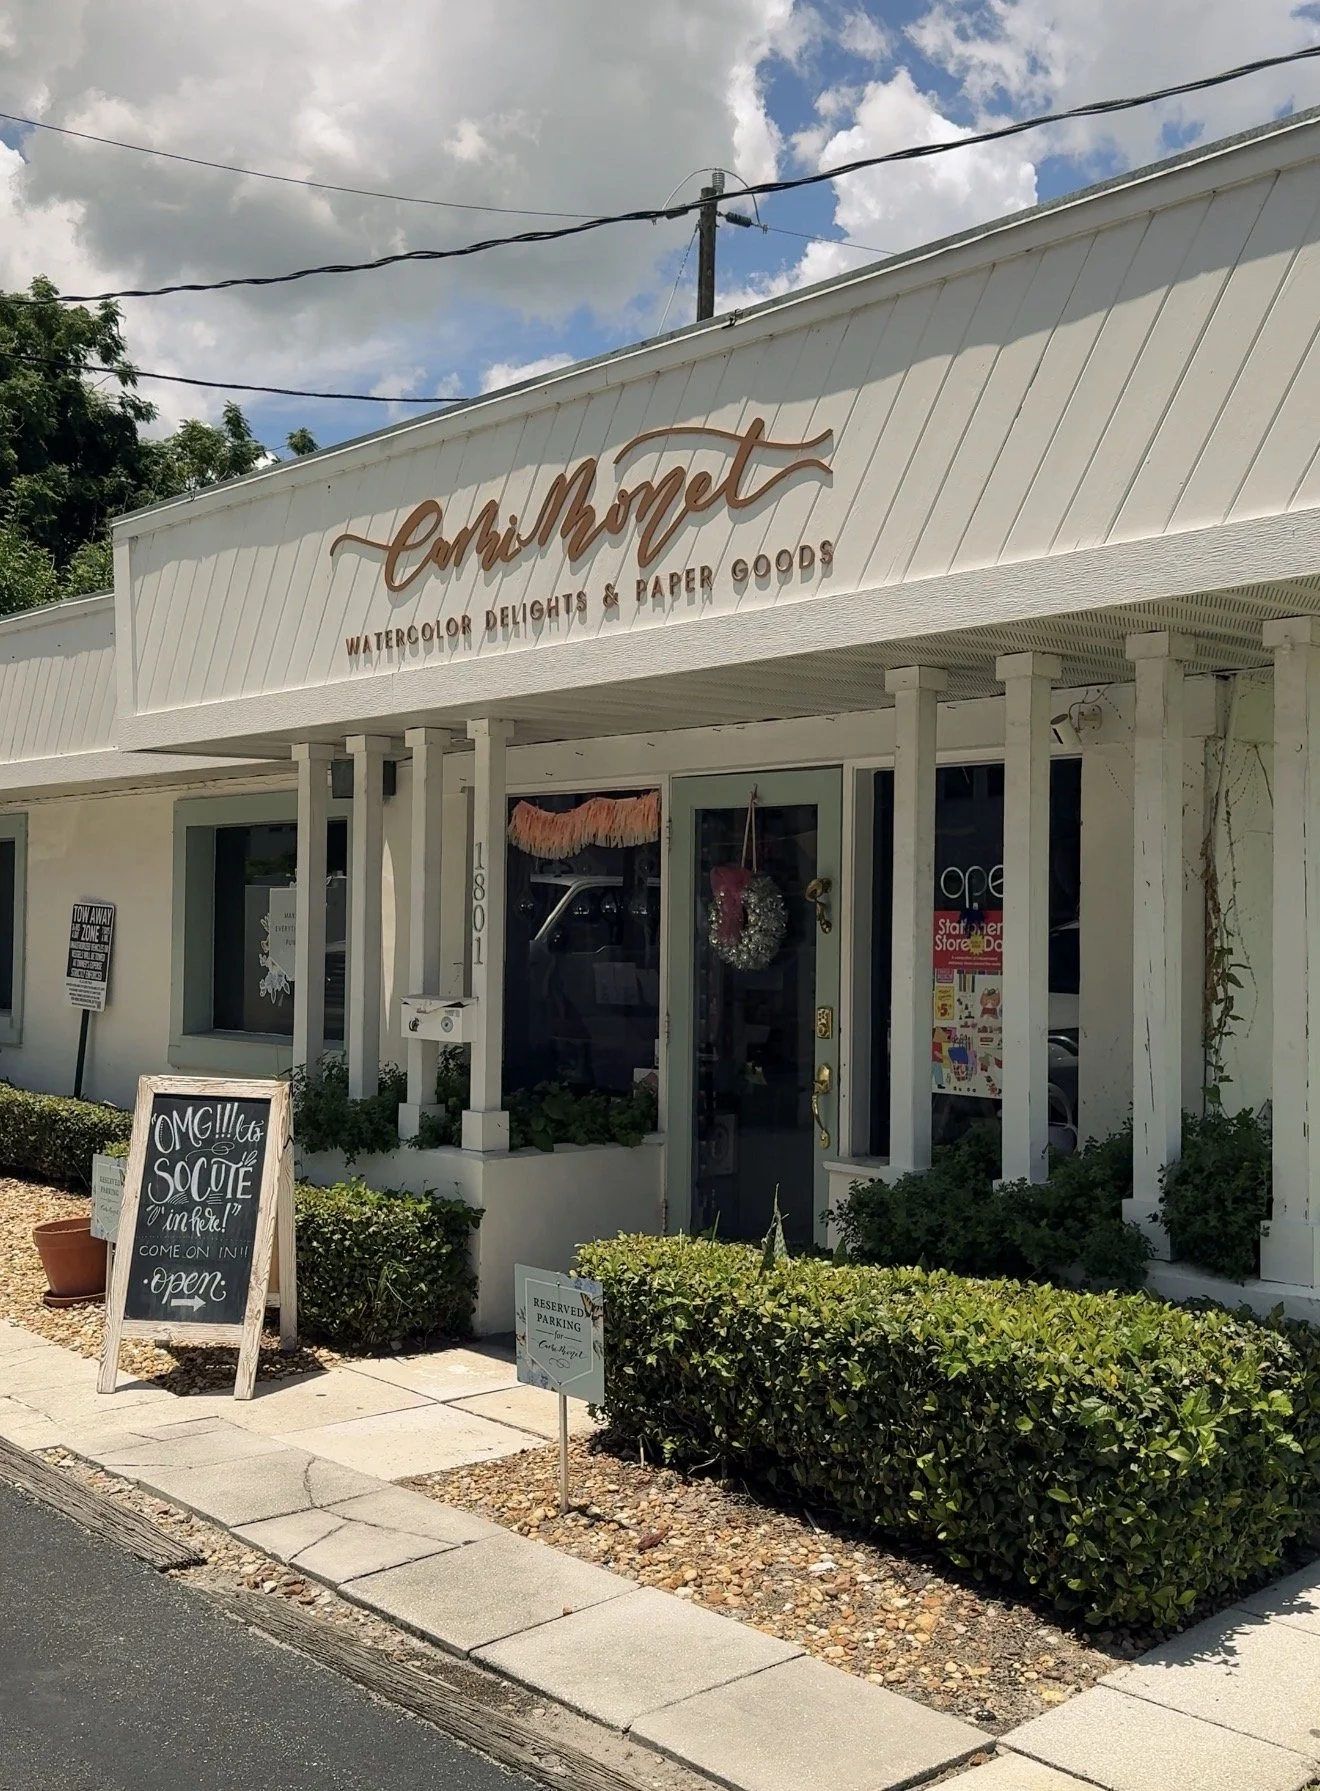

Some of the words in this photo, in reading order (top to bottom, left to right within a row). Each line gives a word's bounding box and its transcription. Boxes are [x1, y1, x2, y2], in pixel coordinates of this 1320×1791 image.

[346, 614, 472, 656] WATERCOLOR
[485, 590, 588, 631] DELIGHTS
[602, 582, 620, 608] &
[636, 564, 713, 602] PAPER
[731, 540, 834, 583] GOODS
[473, 842, 486, 965] 1801
[73, 906, 90, 923] TOW
[90, 907, 112, 926] AWAY
[81, 924, 100, 943] ZONE
[162, 1209, 189, 1232] in
[139, 1244, 181, 1259] COME
[185, 1246, 210, 1259] ON
[533, 1297, 584, 1318] RESERVED
[536, 1312, 582, 1333] PARKING
[554, 1330, 564, 1340] for
